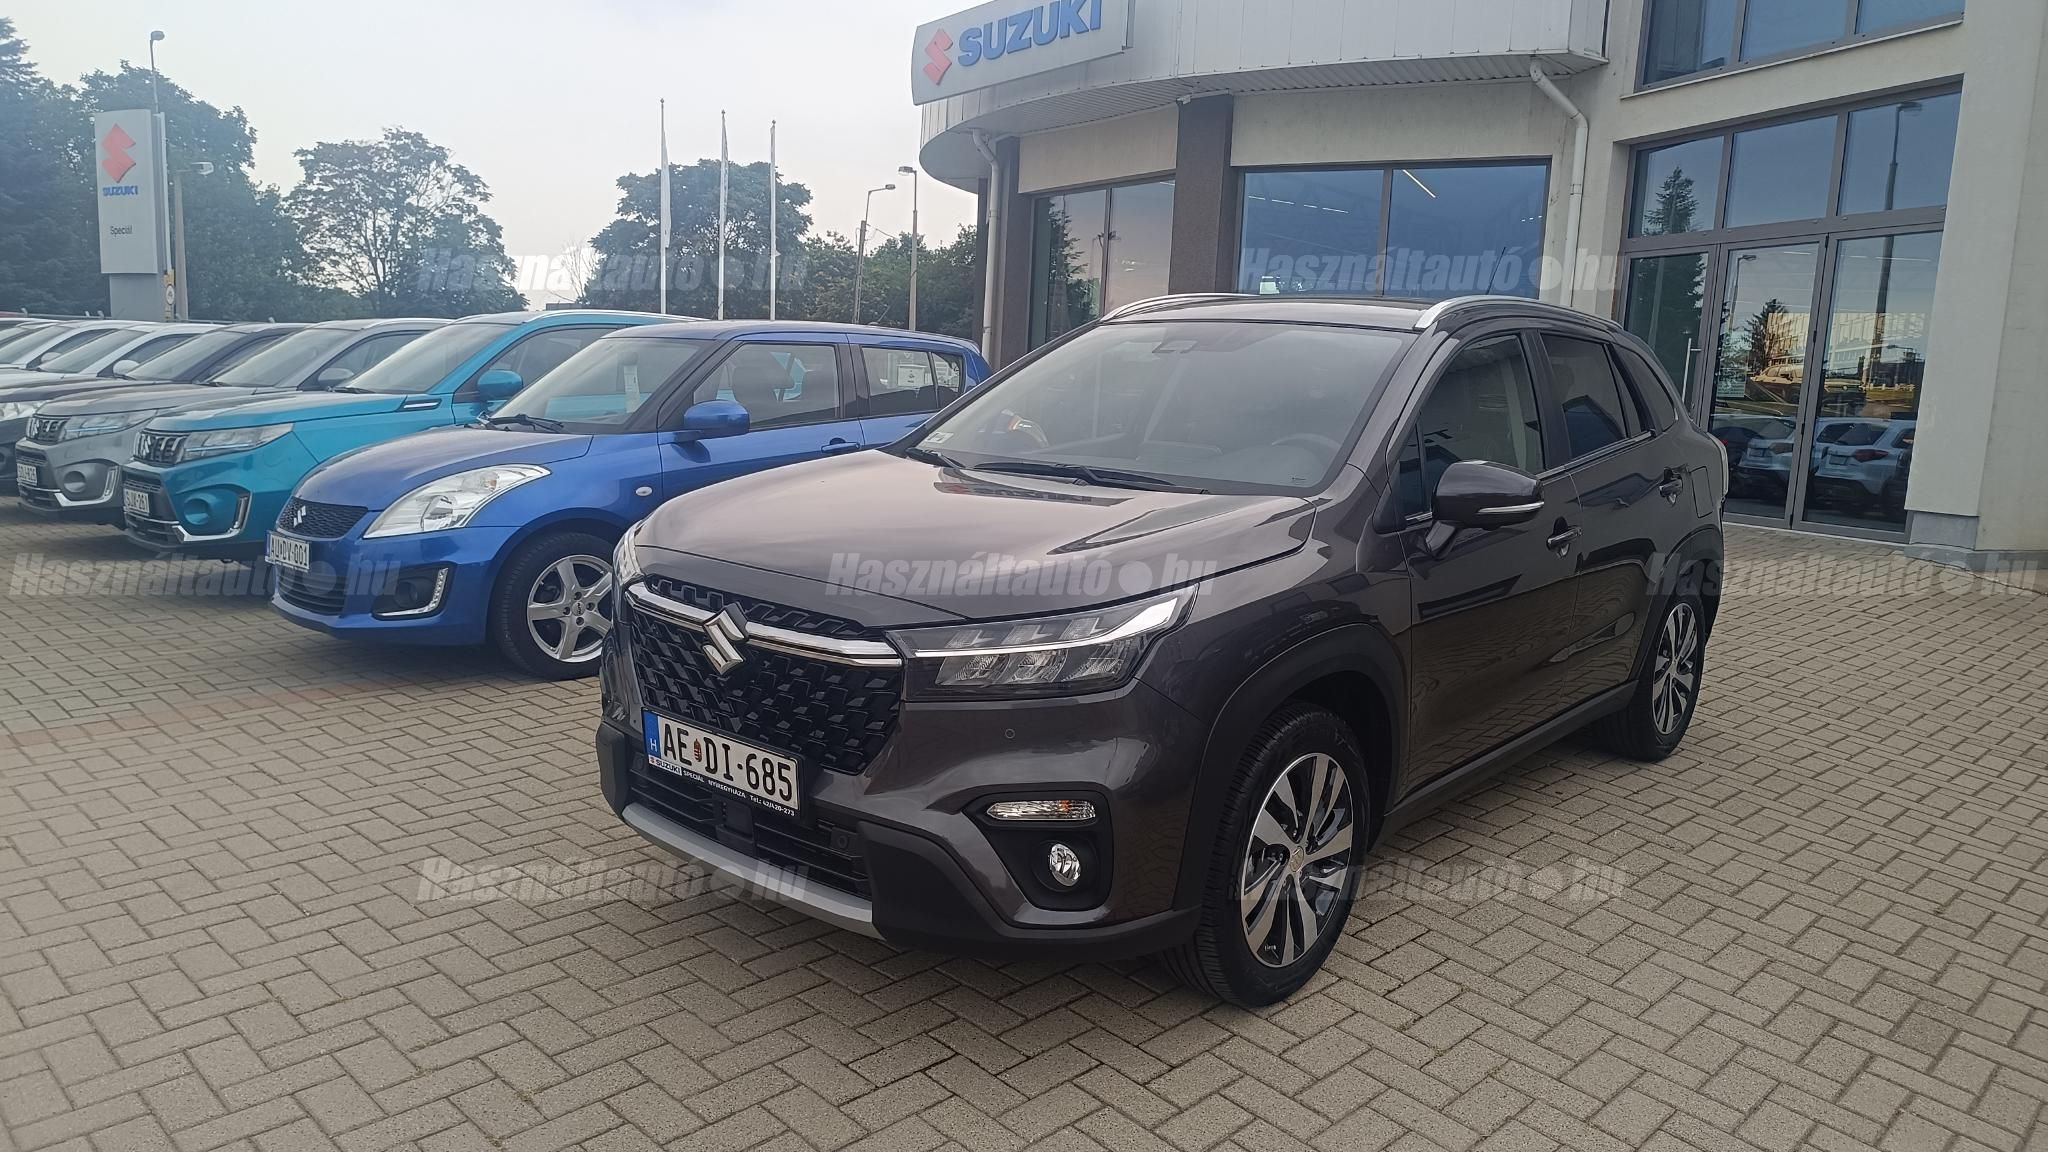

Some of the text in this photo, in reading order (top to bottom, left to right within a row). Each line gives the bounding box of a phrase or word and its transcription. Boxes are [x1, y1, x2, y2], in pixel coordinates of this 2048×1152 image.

[958, 0, 1101, 67] SUZUKI
[103, 186, 139, 196] SUZUKI
[649, 738, 658, 753] H
[656, 759, 682, 776] SUZUKI
[663, 723, 793, 802] AE DI-685
